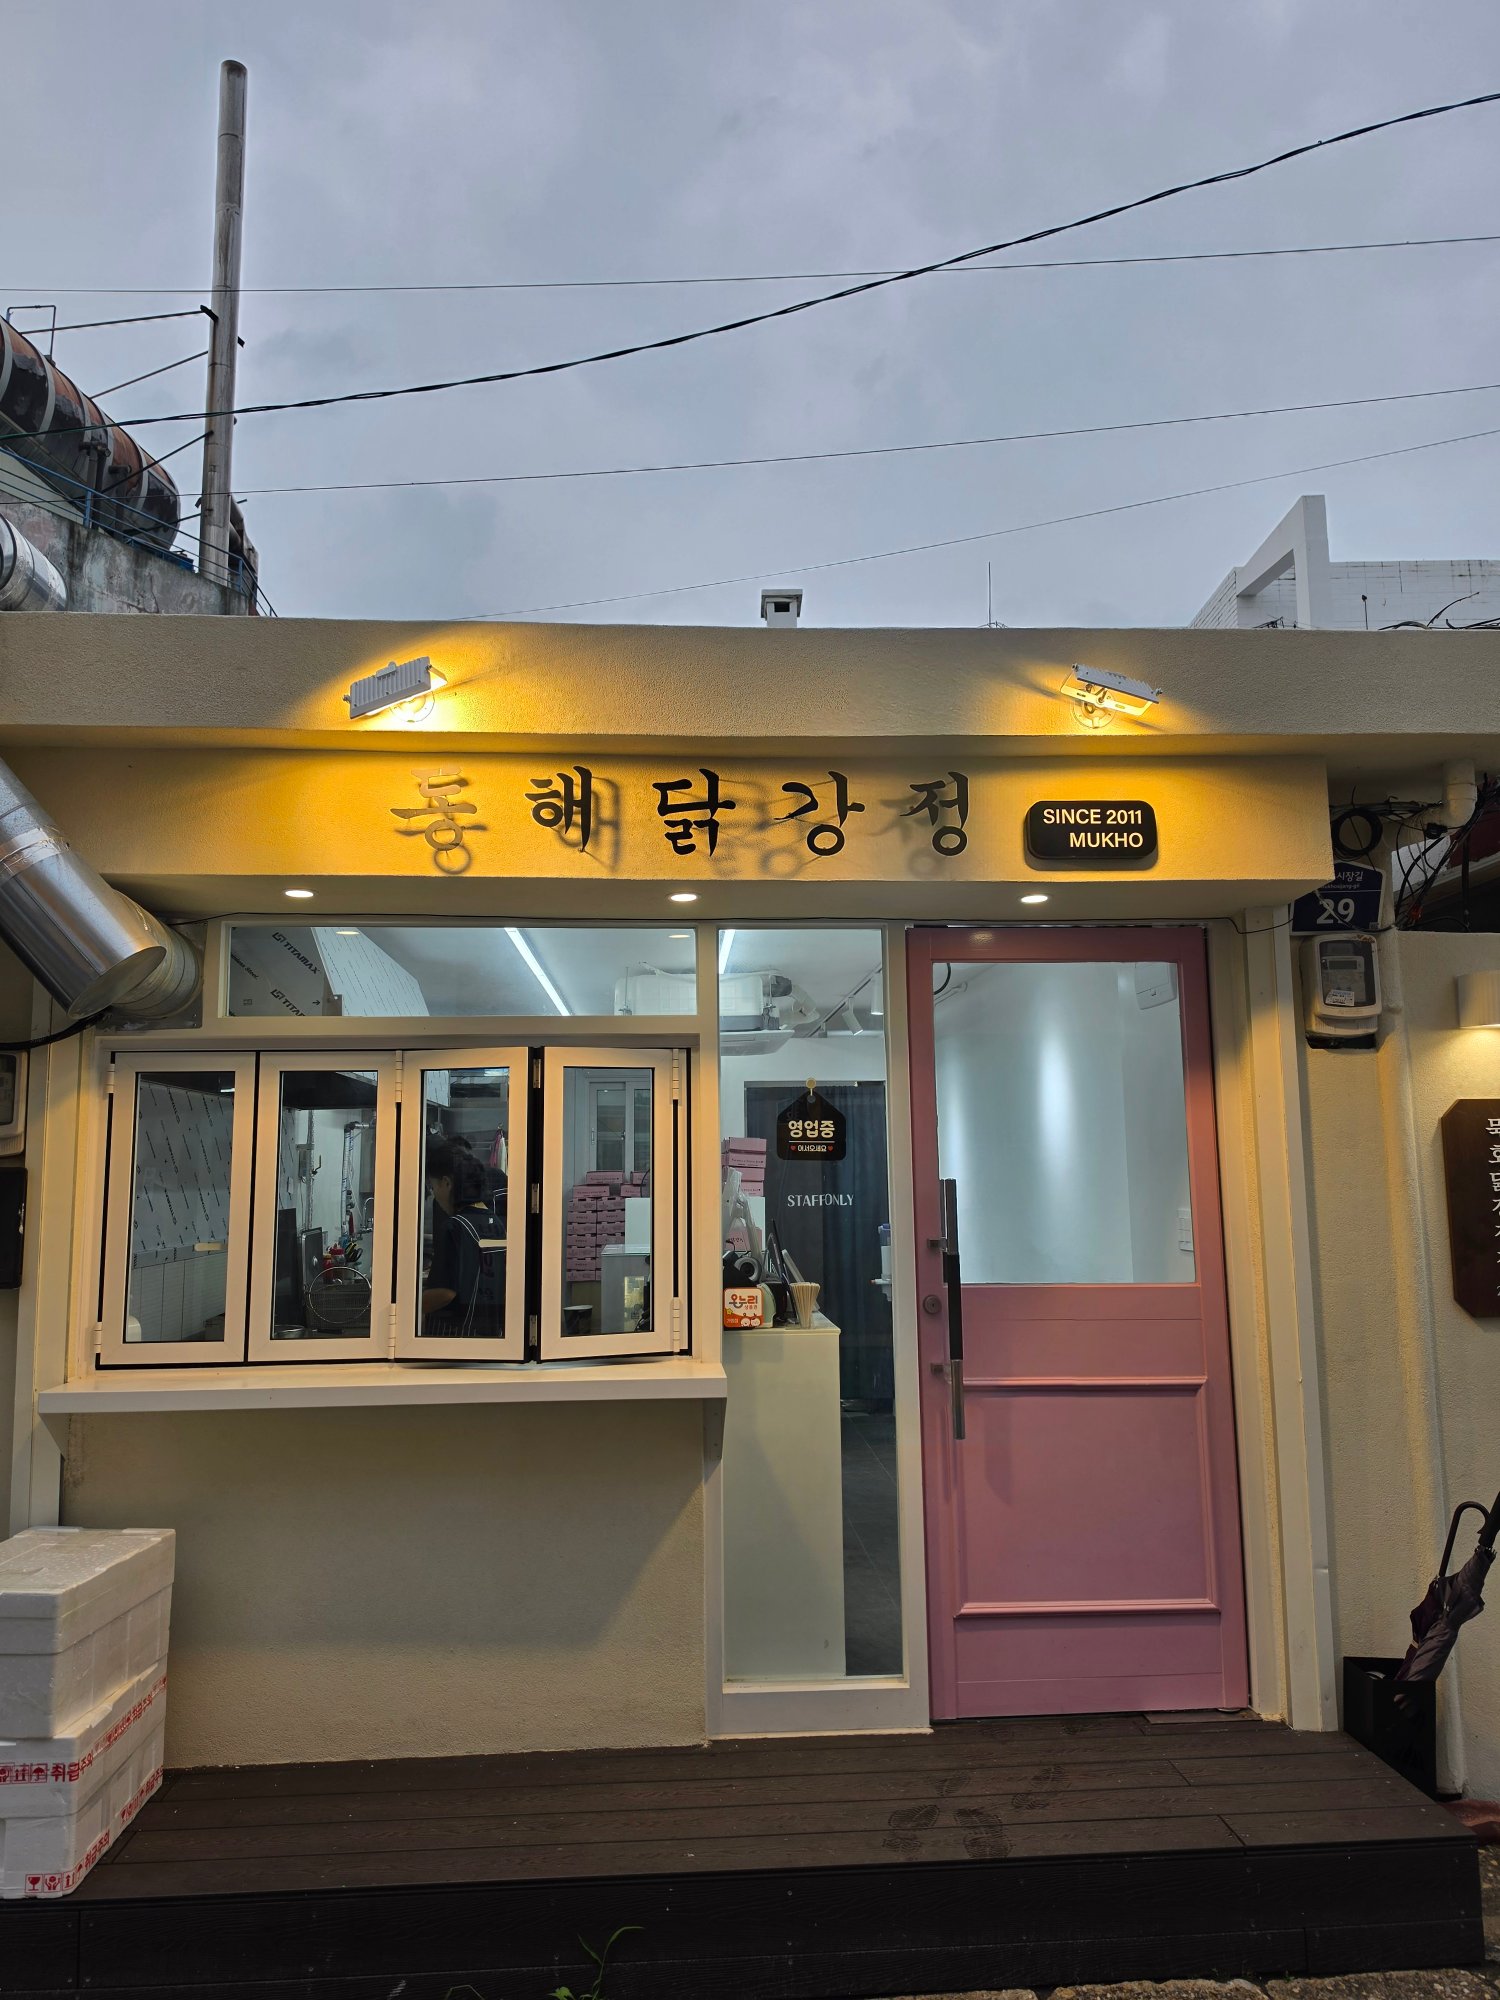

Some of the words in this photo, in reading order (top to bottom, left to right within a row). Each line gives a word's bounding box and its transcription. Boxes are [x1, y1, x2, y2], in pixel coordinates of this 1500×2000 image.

[1043, 808, 1101, 824] SINCE
[1106, 809, 1142, 824] 2011
[1069, 832, 1143, 848] MUKHO
[1316, 898, 1355, 925] 29
[284, 942, 320, 974] TITAMAX
[788, 1119, 836, 1138] 영업중
[797, 1144, 827, 1152] 어서오세요
[787, 1194, 824, 1207] STAFF
[824, 1193, 855, 1206] ONLY
[728, 1293, 759, 1309] 온누리
[51, 1751, 93, 1782] 취급주의
[84, 1829, 110, 1870] 취급주의
